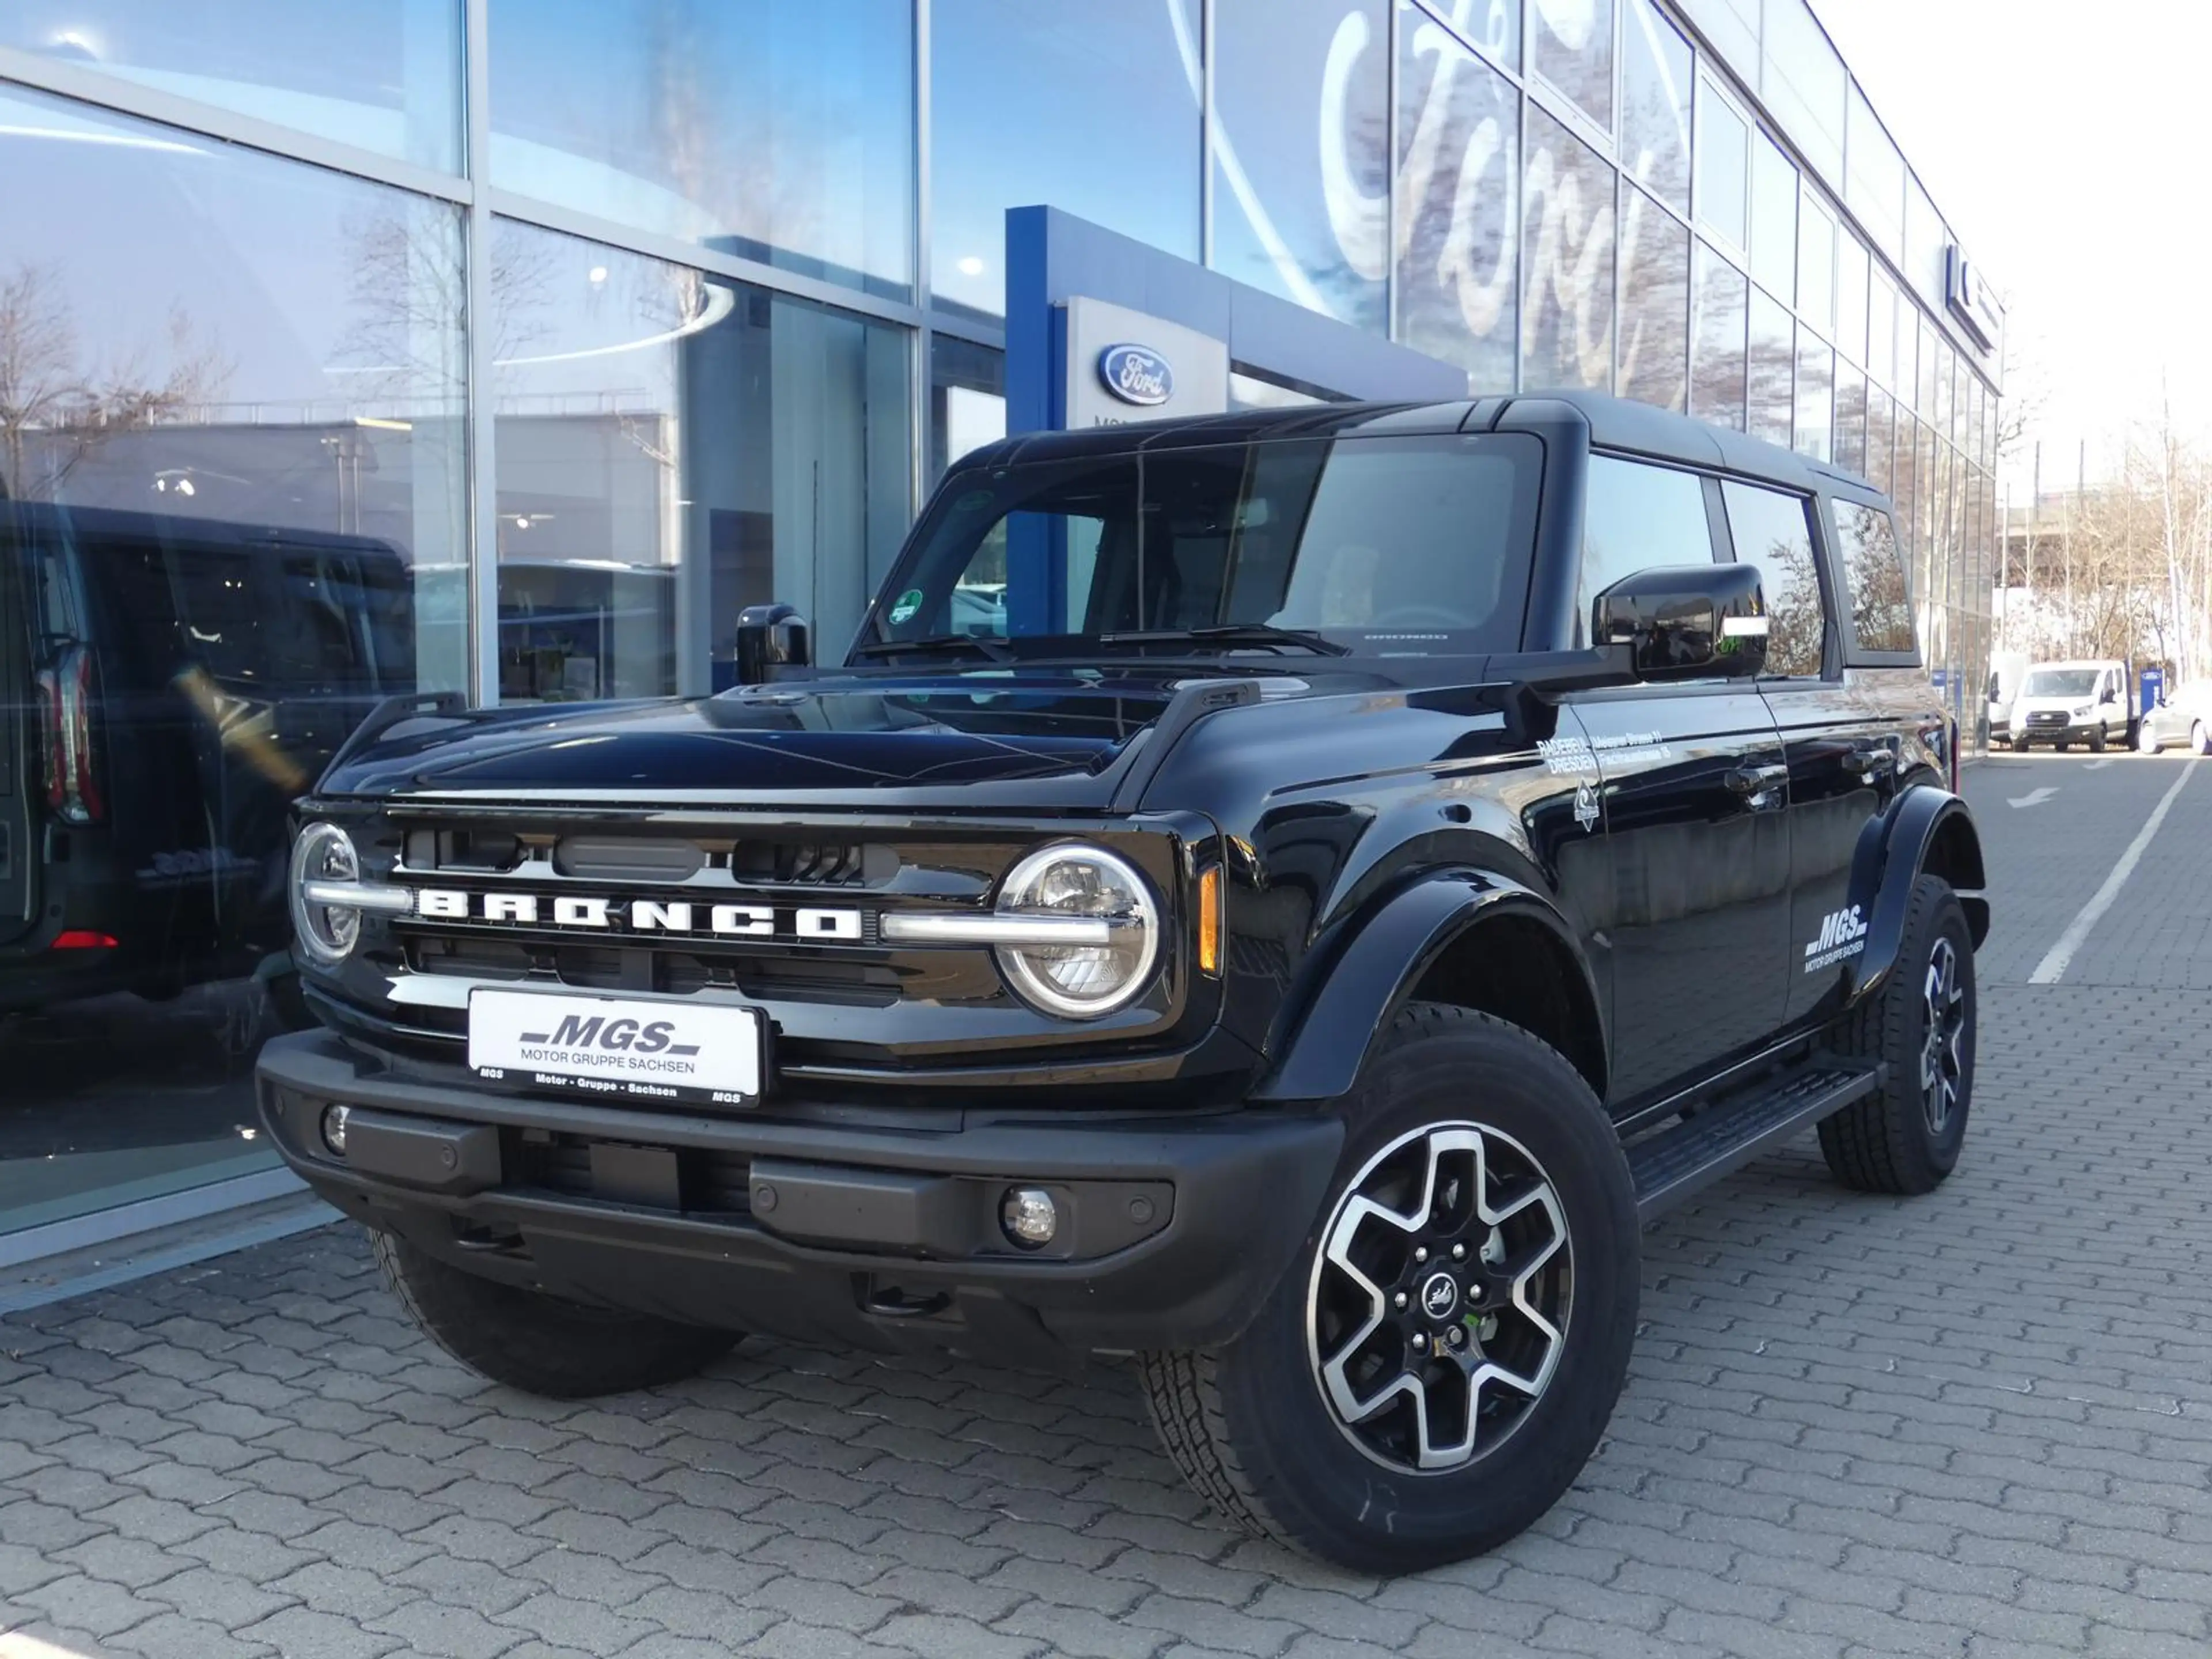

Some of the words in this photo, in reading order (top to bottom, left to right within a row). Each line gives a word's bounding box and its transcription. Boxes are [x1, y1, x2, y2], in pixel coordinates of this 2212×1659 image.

[1120, 354, 1164, 395] Ford
[1547, 753, 1600, 774] DRESDEN
[419, 889, 862, 938] BRONCO
[1818, 904, 1861, 952] MGS
[550, 1014, 676, 1053] MGS
[480, 1067, 504, 1079] MGS
[521, 1048, 569, 1063] MOTOR
[571, 1052, 625, 1068] GRUPPE
[628, 1058, 695, 1074] SACHSEN
[535, 1073, 567, 1086] Motor
[577, 1078, 617, 1092] Gruppe
[628, 1083, 677, 1097] Sachsen
[712, 1092, 741, 1103] MGS
